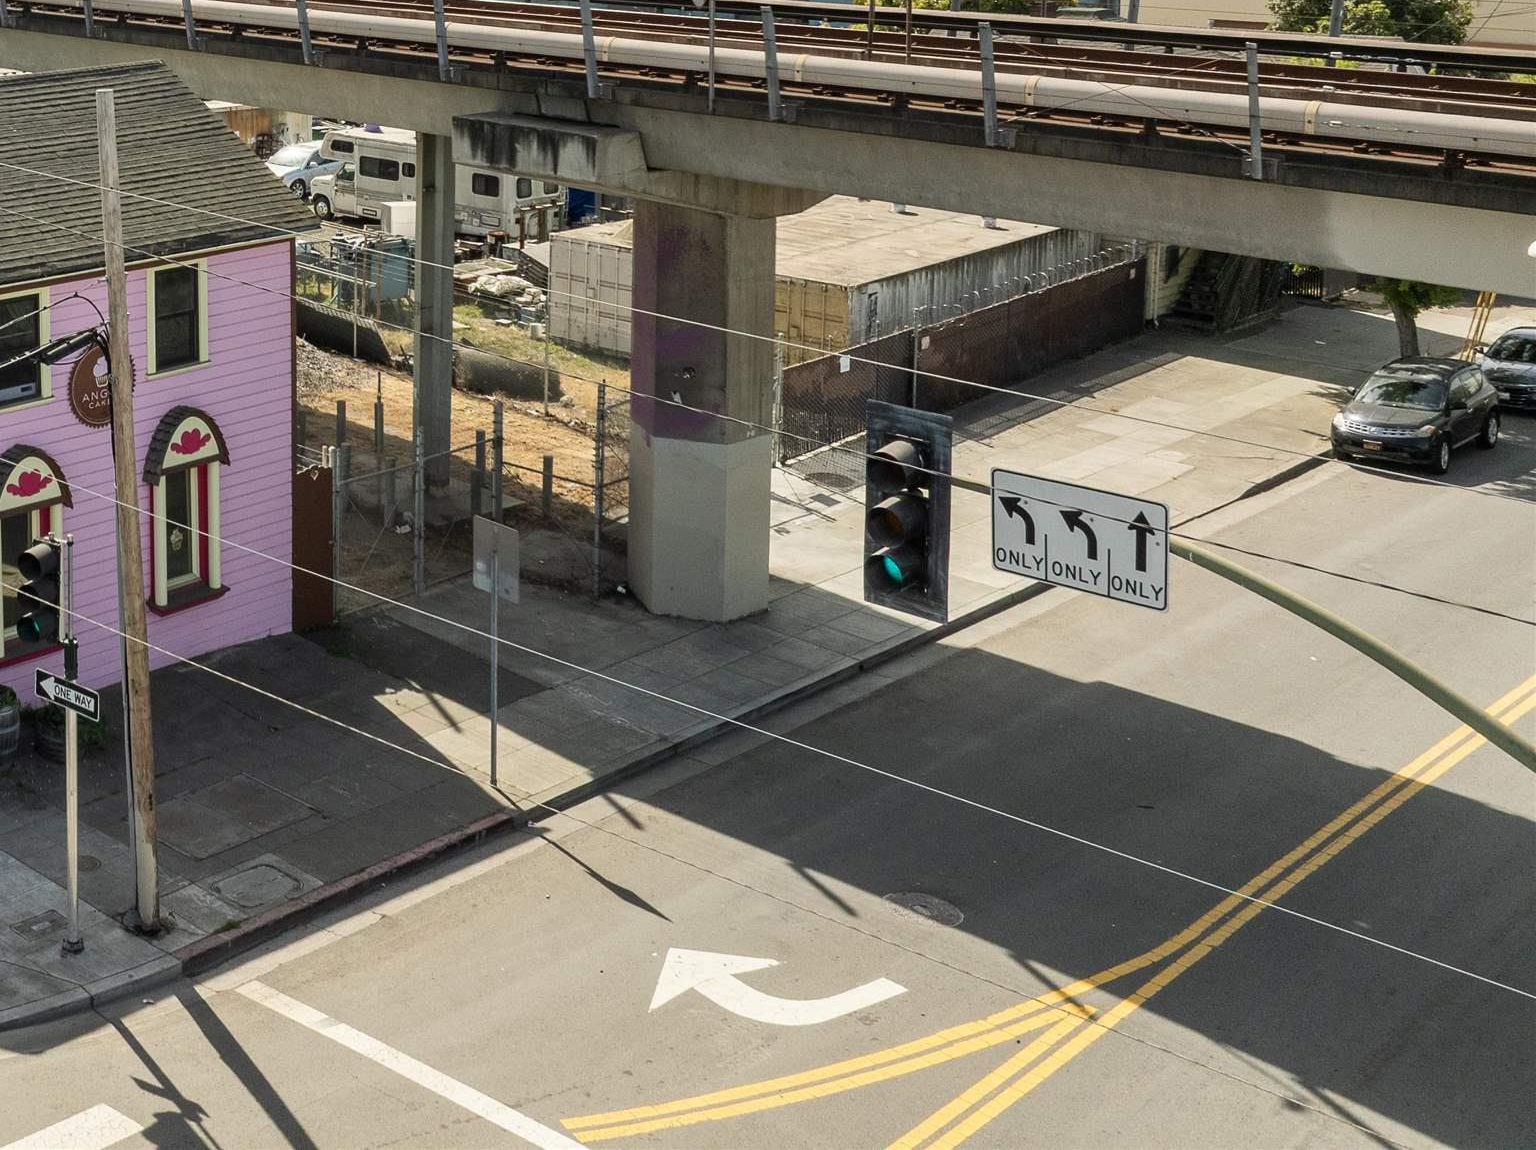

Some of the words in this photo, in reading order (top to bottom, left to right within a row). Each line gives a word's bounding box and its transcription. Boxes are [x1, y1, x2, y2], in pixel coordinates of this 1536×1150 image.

[81, 388, 109, 402] ANG
[996, 547, 1044, 571] ONLY
[1052, 561, 1101, 585] ONLY
[1112, 575, 1163, 601] ONLY
[55, 684, 72, 701] ONE
[74, 692, 92, 709] WAY
